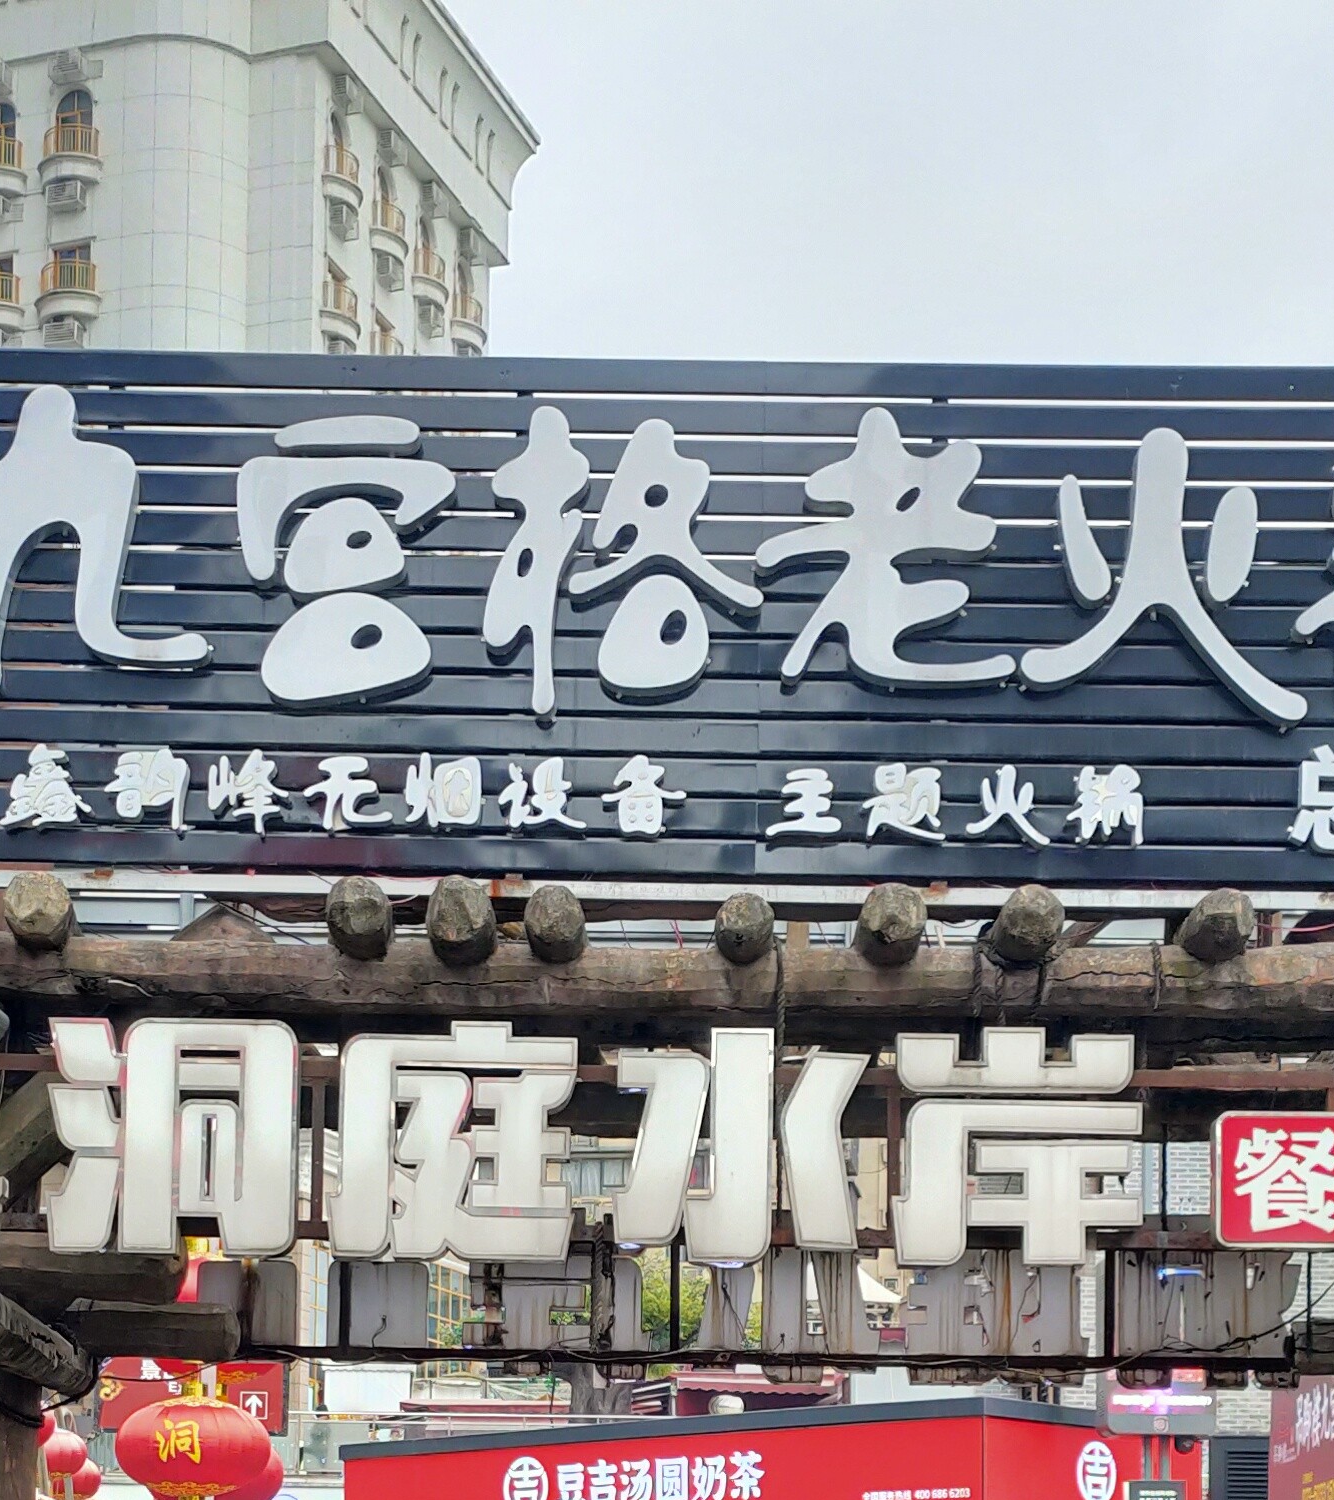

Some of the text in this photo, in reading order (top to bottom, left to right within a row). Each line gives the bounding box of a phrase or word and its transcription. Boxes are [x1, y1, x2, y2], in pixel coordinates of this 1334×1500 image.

[767, 763, 1144, 848] 主题火锅
[48, 1017, 1143, 1268] 洞庭水岸
[156, 1419, 202, 1465] 洞
